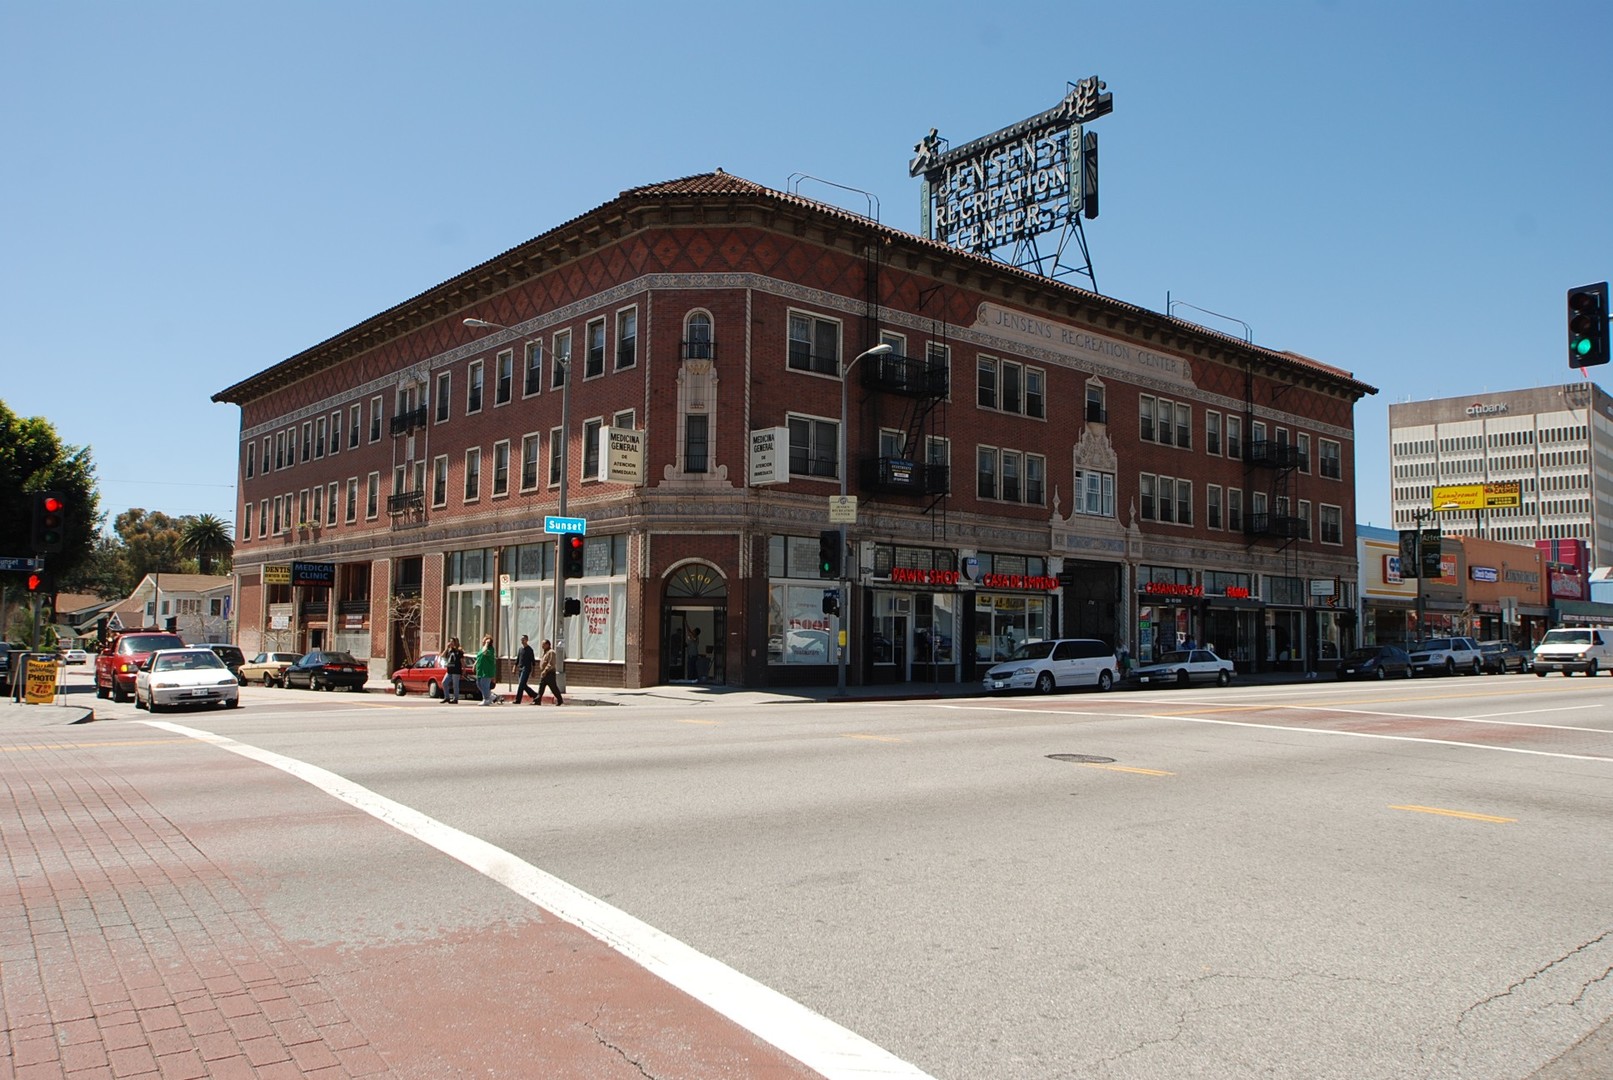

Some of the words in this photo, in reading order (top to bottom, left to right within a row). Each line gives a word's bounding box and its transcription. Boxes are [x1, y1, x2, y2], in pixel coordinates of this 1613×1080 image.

[938, 126, 1058, 197] JENSEN'S
[1070, 126, 1080, 208] BOWLING
[935, 161, 1067, 229] RECREATION
[956, 203, 1041, 249] CENTER
[995, 311, 1051, 339] JENSEN'S
[1061, 329, 1130, 360] RECREATION
[1137, 352, 1177, 373] CENTER
[1465, 402, 1508, 415] citibank
[611, 433, 640, 444] MEDICINA
[753, 434, 775, 444] MEDICINA
[611, 442, 639, 452] GENERAL
[753, 443, 774, 453] GENERAL
[549, 520, 582, 531] Sunset
[295, 564, 335, 572] MEDICAL
[684, 574, 711, 584] 1700
[892, 568, 926, 583] PAWN
[929, 570, 960, 585] SHOP
[983, 572, 1009, 588] CASA
[1010, 575, 1022, 589] DE
[583, 605, 610, 617] Organic
[586, 615, 607, 627] Vegan
[28, 673, 55, 681] PHOTO
